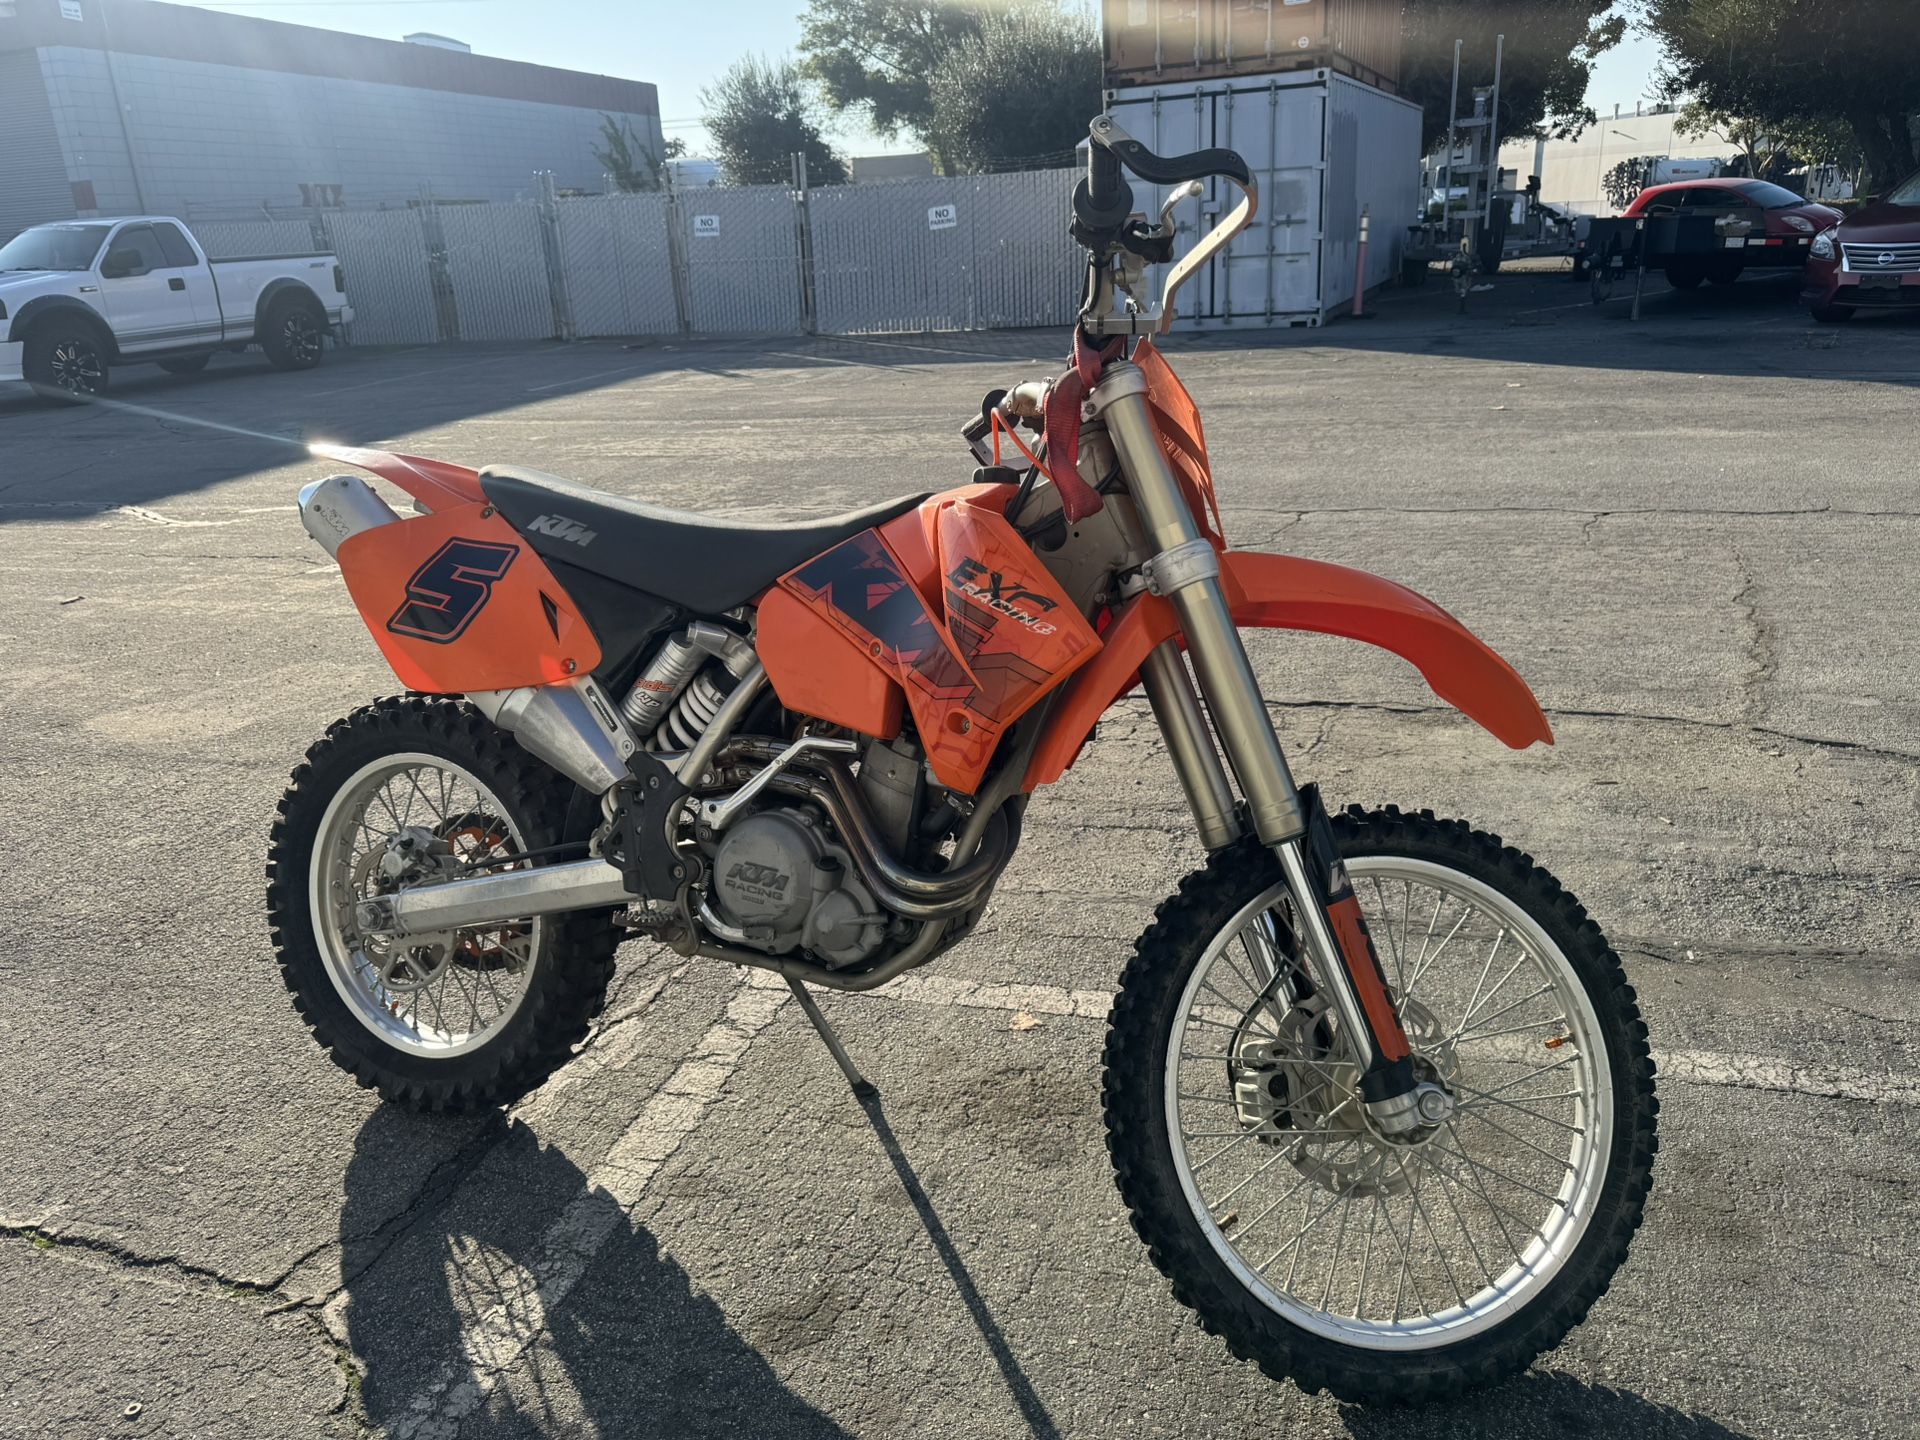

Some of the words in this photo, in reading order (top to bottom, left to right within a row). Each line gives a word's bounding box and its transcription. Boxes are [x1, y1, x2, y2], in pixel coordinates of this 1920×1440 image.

[700, 217, 713, 226] NO
[935, 208, 949, 218] NO
[527, 513, 598, 547] KTM
[959, 582, 1057, 635] RACING
[726, 861, 790, 891] KTM
[725, 879, 784, 901] RACING
